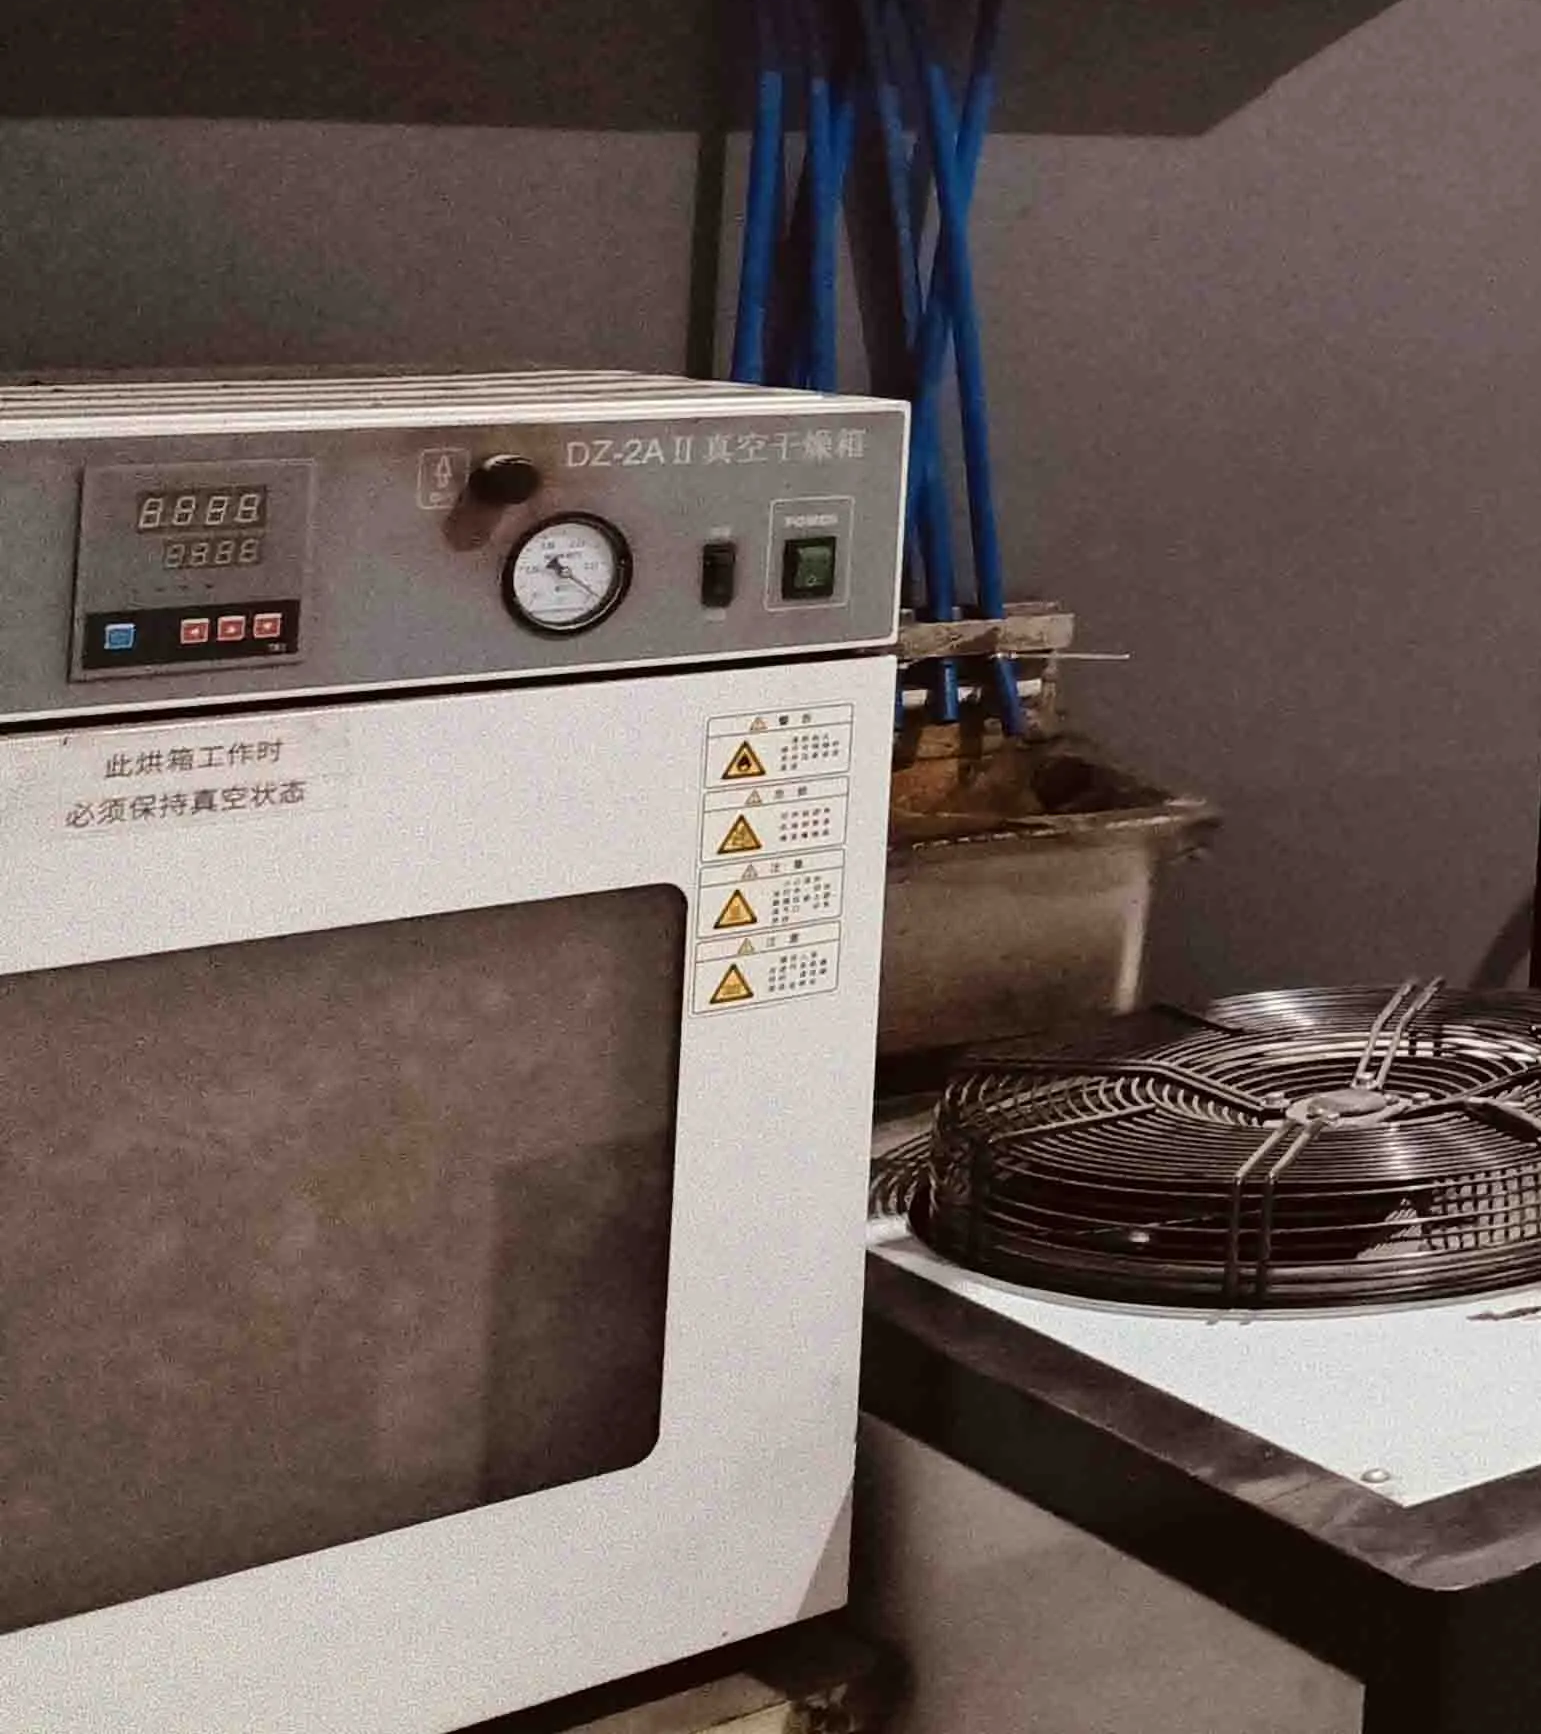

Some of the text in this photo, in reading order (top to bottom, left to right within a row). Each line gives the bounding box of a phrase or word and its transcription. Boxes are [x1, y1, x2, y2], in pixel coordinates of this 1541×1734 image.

[704, 428, 867, 465] 真空干燥箱
[104, 738, 283, 778] 此烘箱工作时
[65, 780, 306, 829] 必须保持真空状态
